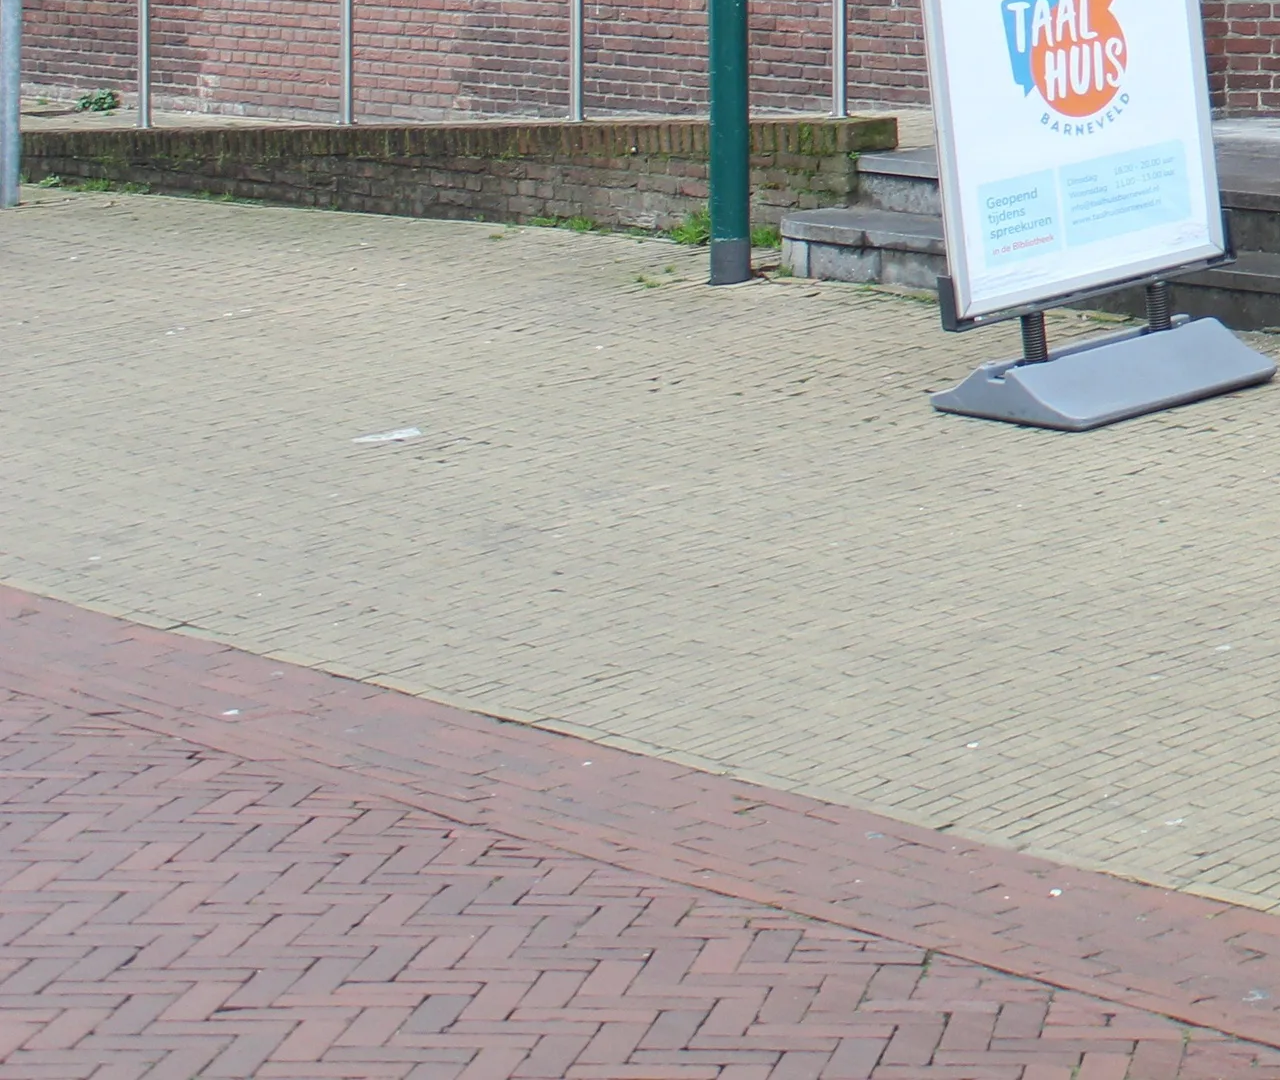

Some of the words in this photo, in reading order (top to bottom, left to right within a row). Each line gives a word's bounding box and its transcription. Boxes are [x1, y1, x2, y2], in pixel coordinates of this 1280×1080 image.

[1044, 38, 1125, 102] HUIS
[1039, 91, 1131, 137] BARNEVELD
[986, 187, 1038, 210] Geopend
[988, 207, 1026, 226] tijdens
[990, 216, 1052, 240] spreekuren
[1001, 245, 1011, 253] de
[1012, 234, 1054, 251] Bibliotheek
